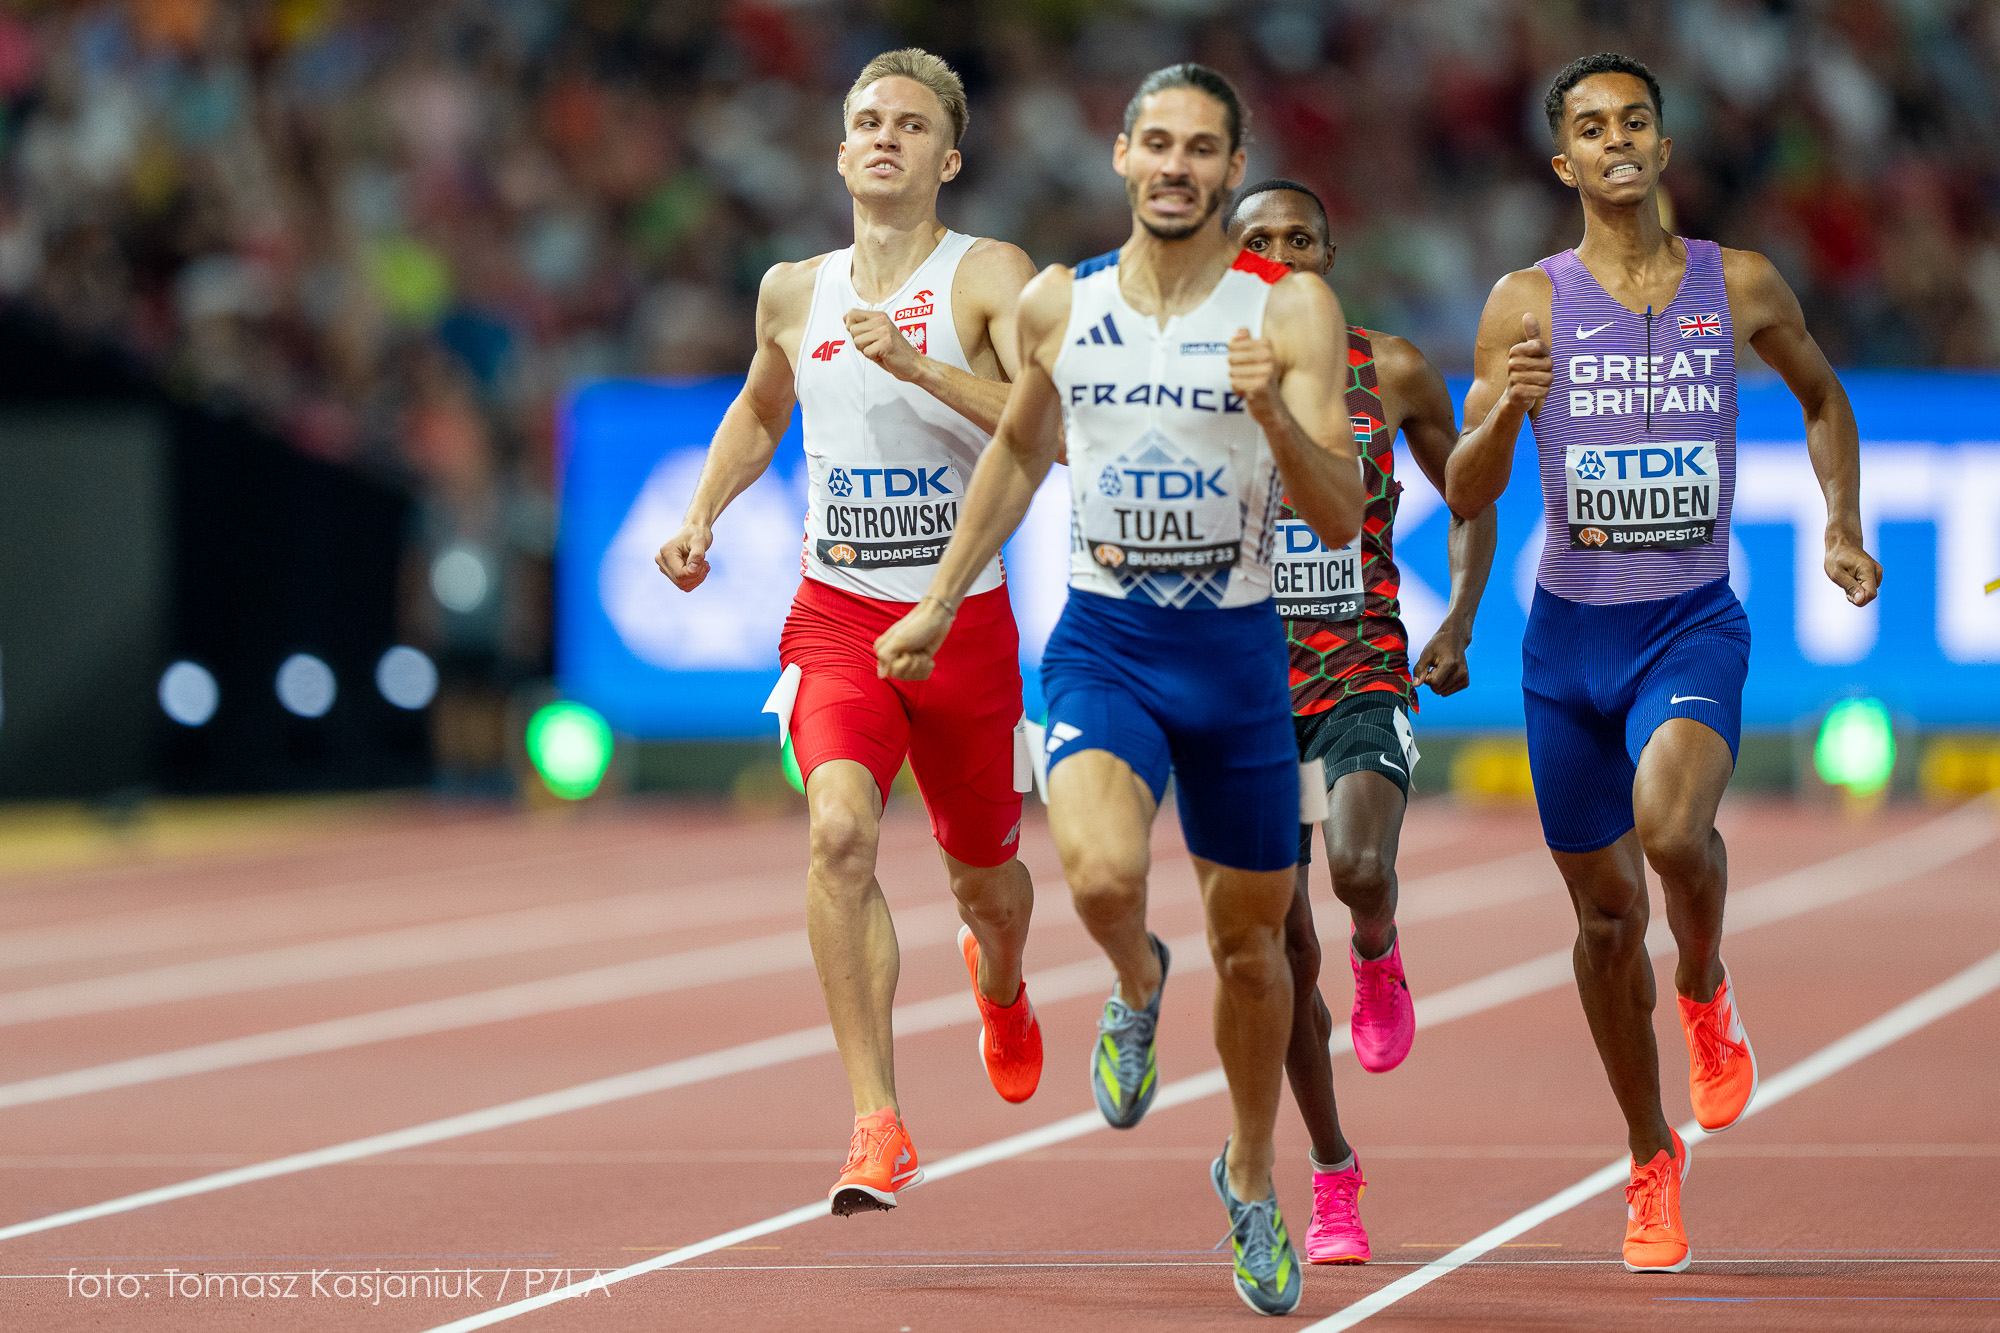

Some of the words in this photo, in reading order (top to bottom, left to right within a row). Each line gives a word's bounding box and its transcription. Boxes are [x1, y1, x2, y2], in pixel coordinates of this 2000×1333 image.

[896, 306, 931, 319] ORLEN
[812, 340, 845, 361] 4F
[1569, 349, 1719, 383] GREAT
[1071, 384, 1245, 413] FRANCE
[1569, 384, 1719, 417] BRITAIN
[1605, 446, 1707, 480] TDK
[851, 465, 954, 498] TDK
[1122, 467, 1228, 499] TDK
[1576, 485, 1710, 521] ROWDEN
[826, 501, 957, 538] OSTROWSKI
[1114, 508, 1204, 541] TUAL
[1612, 528, 1691, 544] BUDAPEST
[1692, 526, 1706, 538] 23
[861, 545, 941, 561] BUDAPEST
[1127, 551, 1213, 566] BUDAPEST
[1214, 549, 1235, 563] 23
[1274, 558, 1355, 593] GETICH
[1339, 600, 1357, 613] 23
